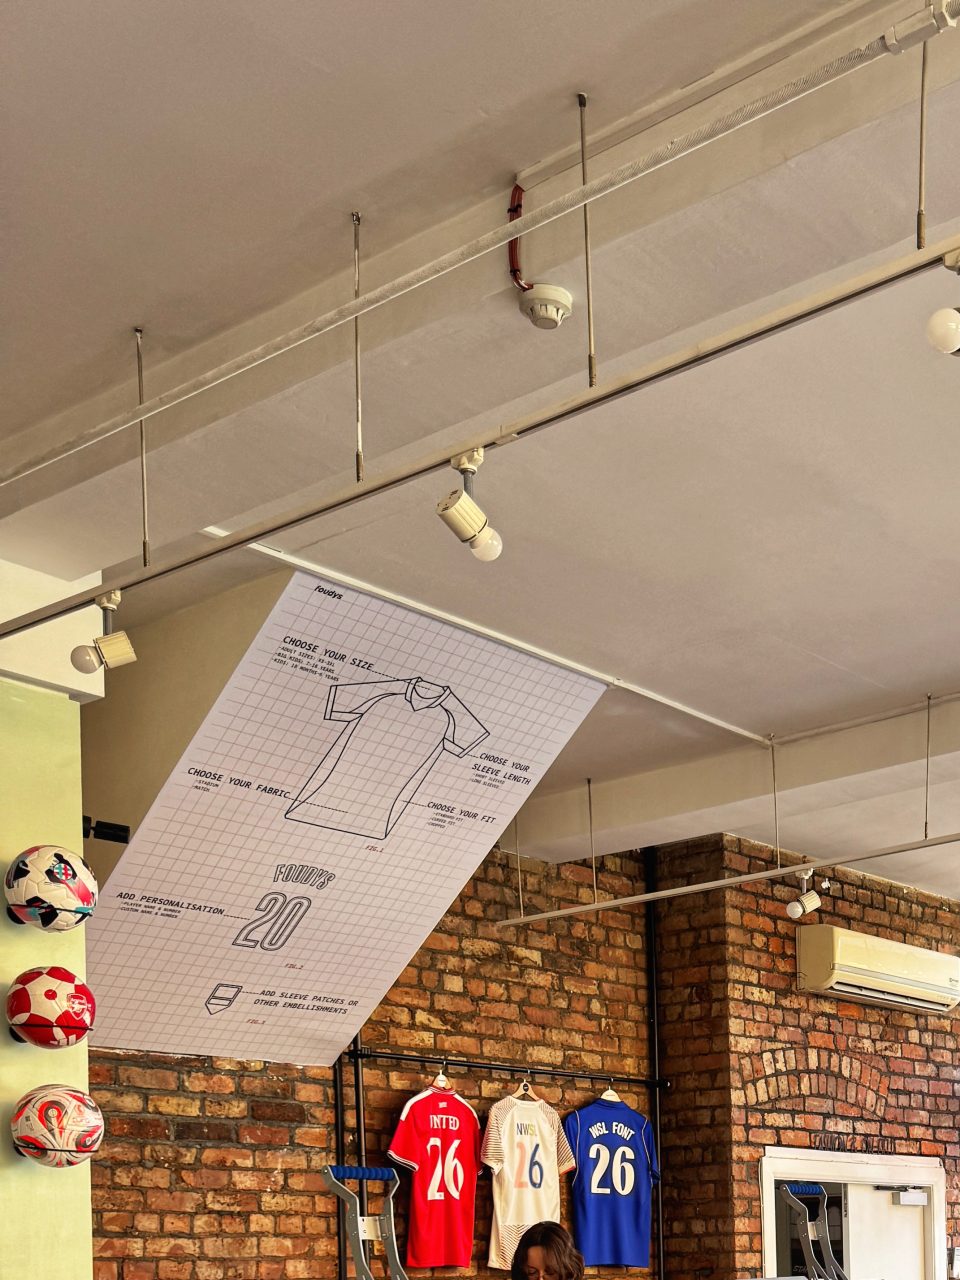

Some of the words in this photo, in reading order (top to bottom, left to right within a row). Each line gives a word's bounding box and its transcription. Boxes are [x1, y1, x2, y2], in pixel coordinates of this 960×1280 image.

[314, 585, 344, 600] foudys
[283, 636, 319, 653] CHOOSE
[324, 649, 347, 662] YOUR
[350, 658, 375, 671] SIZE
[472, 764, 500, 777] SLEEVE
[504, 772, 532, 785] LENGTH
[480, 752, 508, 766] CHOOSE
[512, 762, 530, 773] YOUR
[188, 768, 224, 782] CHOOSE
[229, 777, 252, 789] YOUR
[256, 784, 290, 799] FABRIC
[427, 802, 456, 814] CHOOSE
[460, 810, 478, 820] YOUR
[481, 815, 496, 824] FIT
[272, 863, 336, 890] FOUDYS
[116, 892, 136, 900] ADD
[140, 895, 225, 916] PERSONALISATION
[232, 892, 312, 951] 20
[254, 999, 280, 1007] OTHER
[282, 1002, 348, 1014] EMBELLISHMENTS
[279, 992, 309, 1001] SLEEVE
[312, 996, 345, 1006] PATCHES
[589, 1122, 608, 1138] WSL
[612, 1122, 635, 1140] FONT
[426, 1137, 464, 1200] 26
[514, 1142, 544, 1189] 26
[589, 1143, 634, 1196] 26
